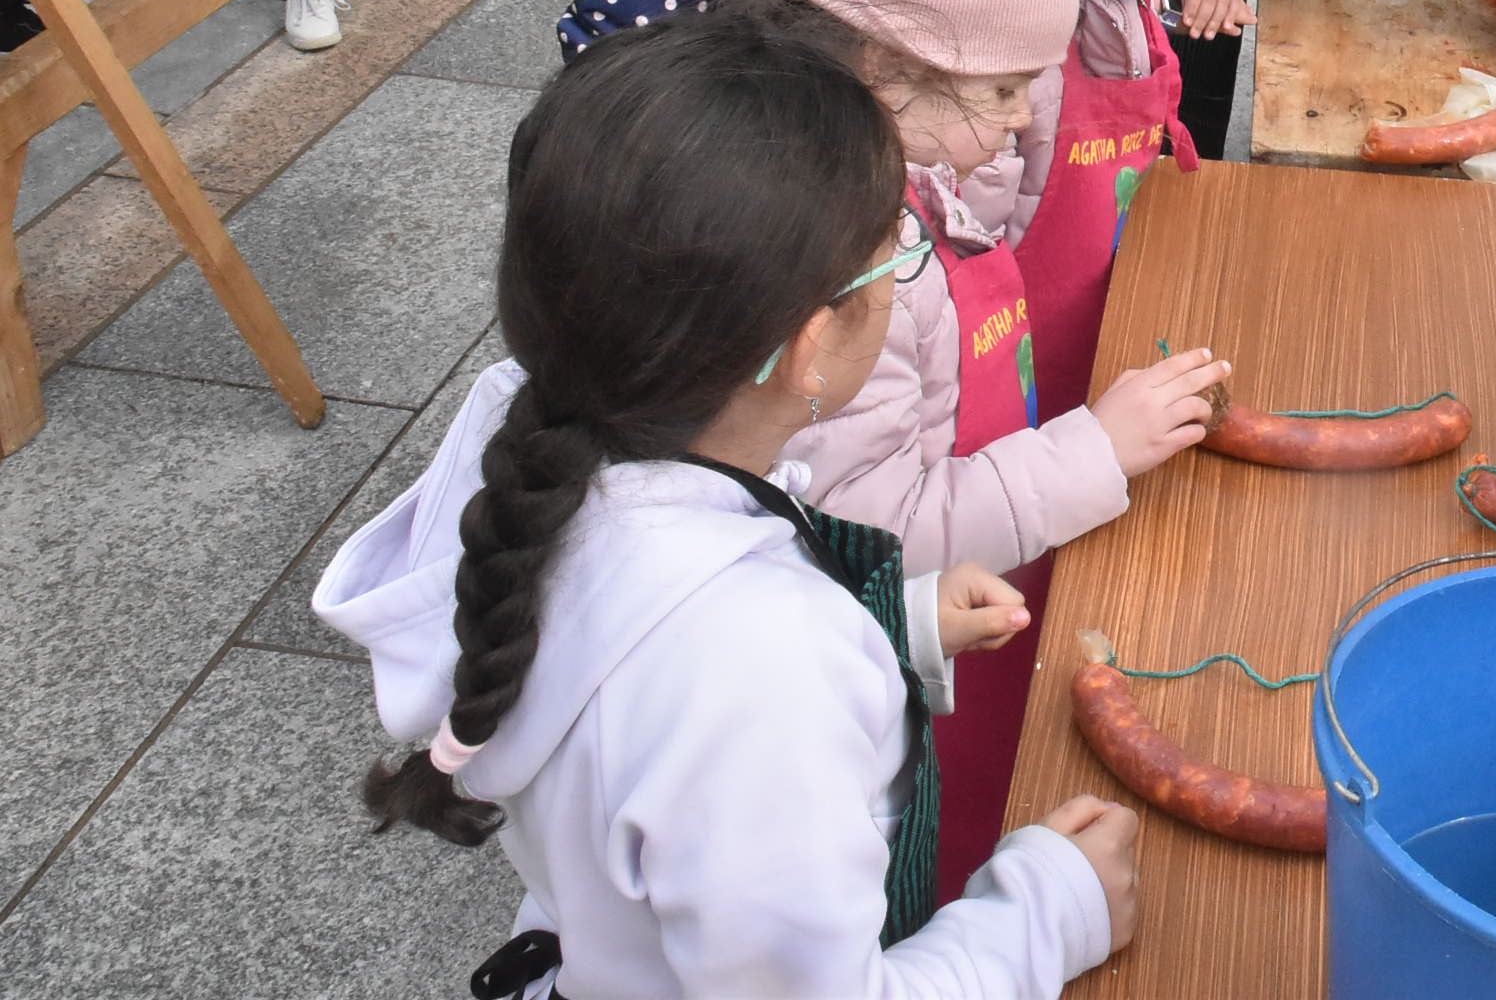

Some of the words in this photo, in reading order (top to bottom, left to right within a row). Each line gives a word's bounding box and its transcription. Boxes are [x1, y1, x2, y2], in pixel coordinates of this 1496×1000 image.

[1068, 138, 1116, 165] AGATHA
[1121, 129, 1145, 156] RUIZ
[1148, 124, 1163, 146] DE
[973, 307, 1014, 360] AGATHA
